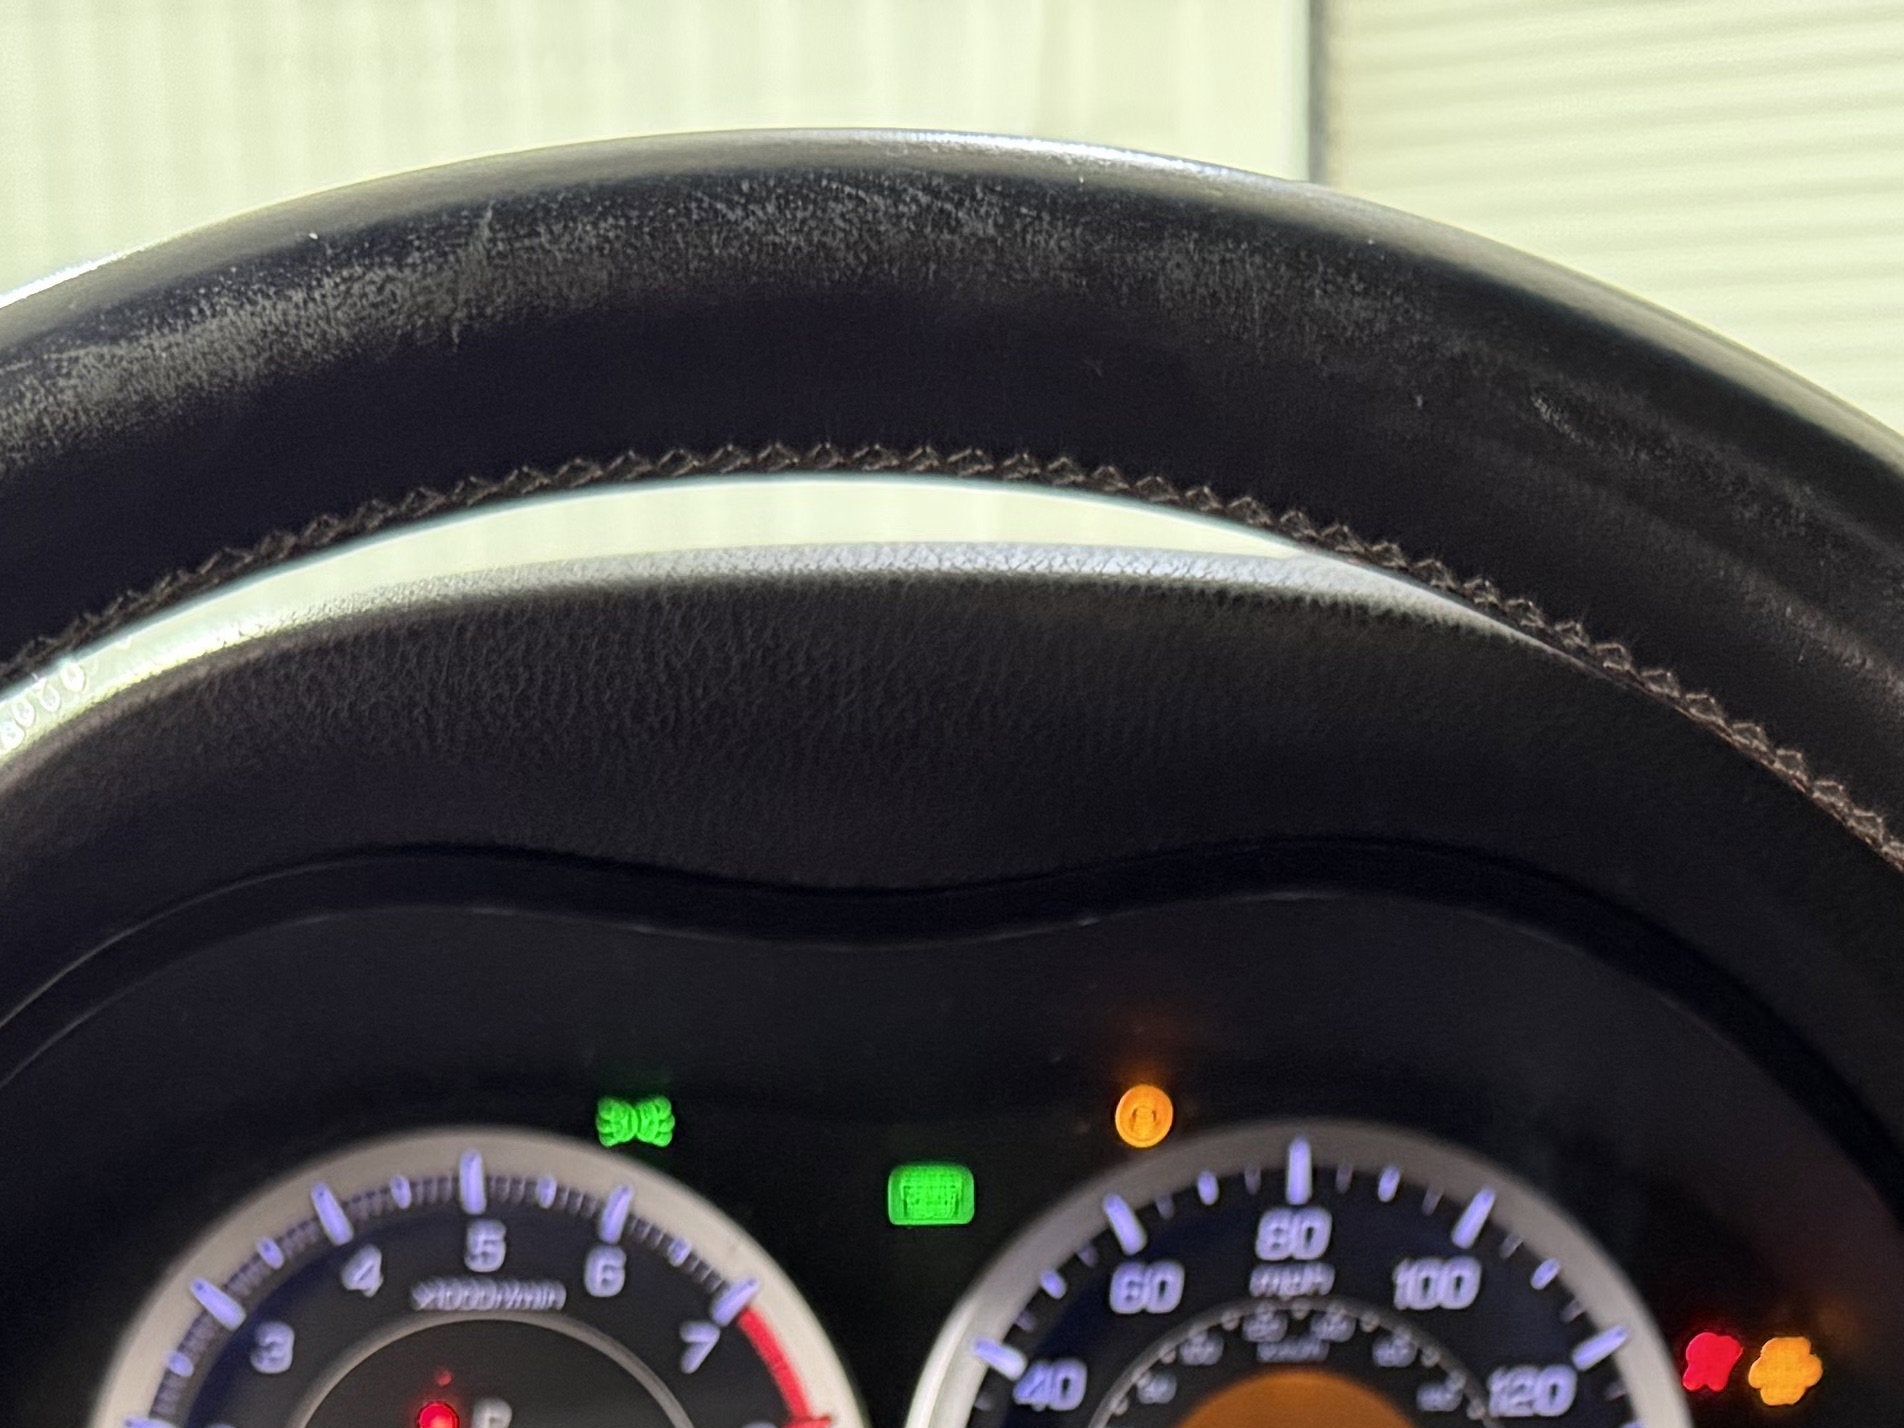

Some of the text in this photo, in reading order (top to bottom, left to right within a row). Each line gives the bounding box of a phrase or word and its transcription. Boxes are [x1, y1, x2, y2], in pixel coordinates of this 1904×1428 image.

[466, 1219, 507, 1272] 5
[1255, 1206, 1333, 1260] 80
[342, 1245, 385, 1297] 4
[585, 1246, 626, 1297] 6
[1110, 1260, 1185, 1314] 60
[1393, 1255, 1483, 1310] 100
[250, 1321, 294, 1373] 3
[681, 1321, 720, 1373] 7
[1012, 1358, 1088, 1412] 40
[1488, 1363, 1578, 1418] 120
